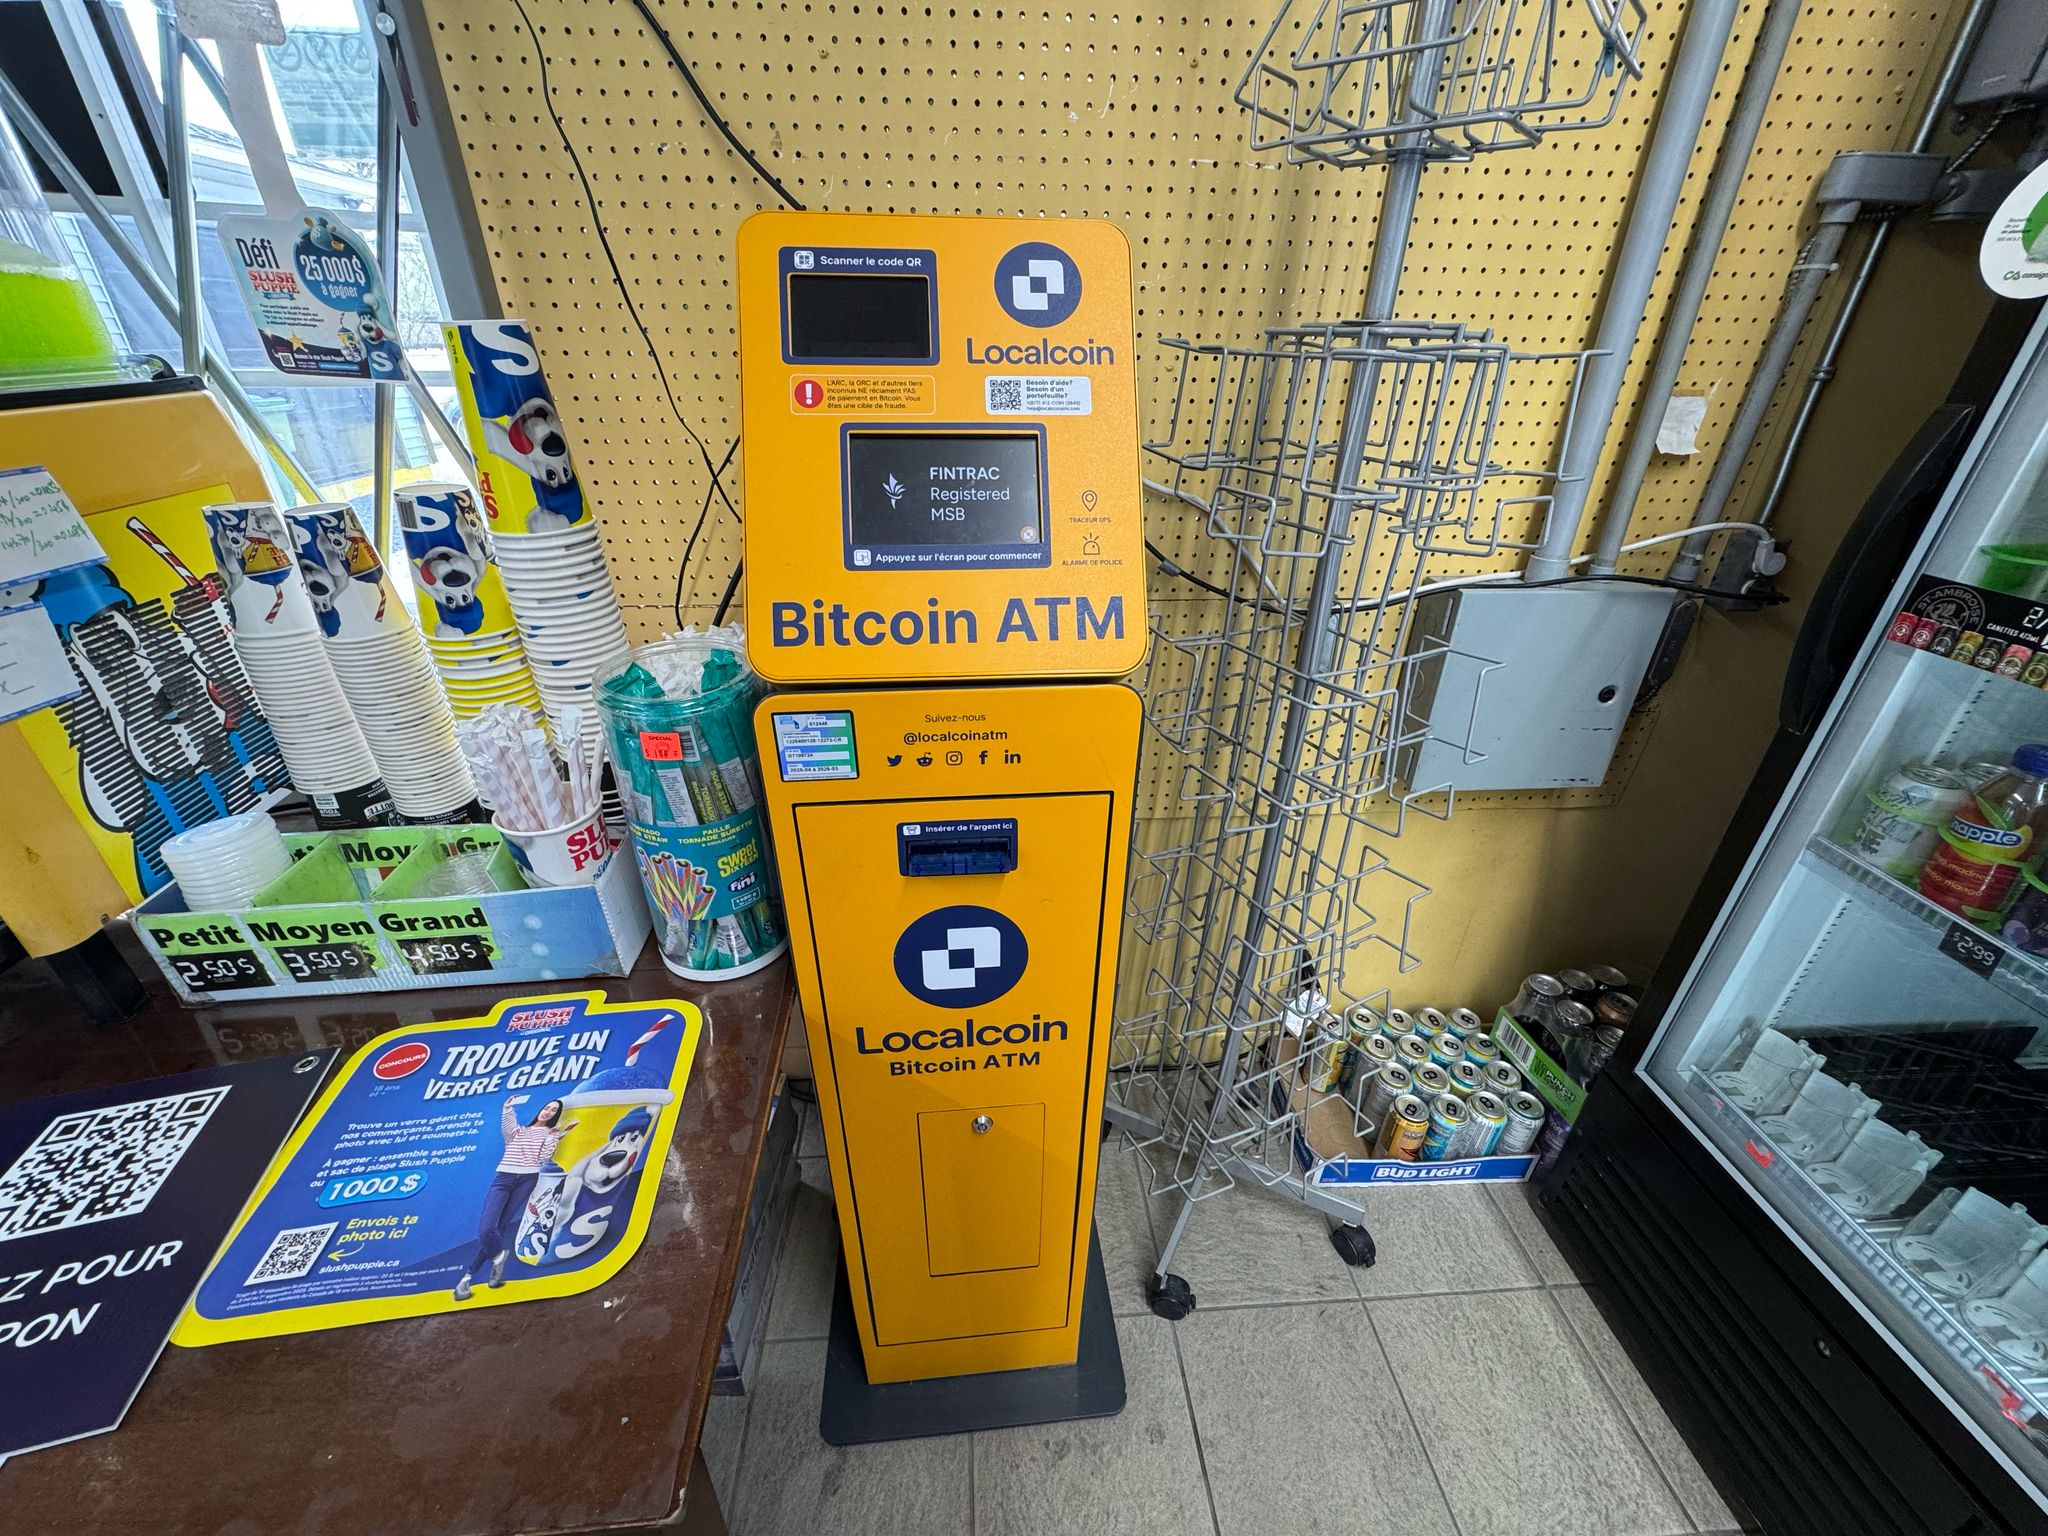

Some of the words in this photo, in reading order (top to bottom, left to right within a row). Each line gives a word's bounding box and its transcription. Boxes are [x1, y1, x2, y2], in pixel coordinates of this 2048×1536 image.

[235, 238, 280, 269] Défi
[820, 256, 864, 266] Scanner
[866, 256, 875, 266] le
[878, 256, 904, 266] code
[906, 259, 922, 267] QR
[248, 270, 296, 283] SLUSH
[253, 282, 300, 294] PUPPIE
[320, 282, 328, 296] à
[328, 285, 358, 299] gagner
[966, 337, 1115, 365] Localcoin
[930, 467, 1000, 480] FINTRAC
[930, 487, 1010, 504] Registered
[931, 508, 966, 521] MSB
[876, 552, 916, 564] Appuyez
[918, 554, 932, 562] sur
[934, 552, 965, 562] l'écran
[966, 554, 987, 564] pour
[989, 551, 1042, 561] commencer
[1918, 588, 1980, 625] ST-AMBROISE
[772, 597, 978, 647] Bitcoin
[996, 595, 1125, 643] ATM
[1987, 623, 2019, 637] CANETTES
[925, 714, 986, 723] Suivez-nous
[904, 730, 1008, 746] @localcoinatm
[678, 834, 719, 844] TORNADE
[720, 820, 754, 839] SURETTE
[703, 824, 731, 836] PAILLE
[925, 825, 955, 833] Insérer
[970, 824, 1001, 832] l'argent
[1003, 822, 1013, 830] ici
[644, 834, 668, 843] STRAW
[340, 842, 418, 863] Moy
[730, 872, 756, 892] Fini
[149, 925, 246, 948] Petit
[246, 919, 375, 944] Moyen
[379, 907, 489, 932] Grand
[402, 943, 460, 967] 4.50
[461, 942, 478, 959] $
[1957, 936, 1996, 966] 2.99
[176, 959, 238, 986] 2.50
[238, 957, 256, 975] $
[282, 951, 342, 977] 3.50
[342, 950, 360, 966] $
[506, 1016, 572, 1034] PUPPIE
[511, 1006, 576, 1024] SLUSH
[856, 1014, 1068, 1054] Localcoin
[378, 1052, 427, 1070] CONCOURS
[439, 1034, 564, 1077] TROUVE
[568, 1029, 610, 1052] UN
[890, 1056, 976, 1077] Bitcoin
[983, 1052, 1040, 1070] ATM
[424, 1073, 506, 1100] VERRE
[504, 1055, 600, 1090] GÉANT
[1546, 1070, 1576, 1101] PUNCH
[340, 1132, 360, 1140] nos
[362, 1126, 434, 1138] commerçants,
[434, 1120, 472, 1132] prends
[348, 1122, 384, 1132] Trouve
[400, 1118, 428, 1126] verre
[428, 1114, 458, 1126] géant
[334, 1138, 366, 1150] photo
[367, 1138, 393, 1146] avec
[394, 1135, 408, 1144] lui
[420, 1129, 480, 1140] soumets-la.
[316, 1170, 328, 1178] et
[330, 1168, 349, 1176] sac
[351, 1166, 364, 1174] de
[366, 1162, 397, 1174] plage
[400, 1158, 428, 1168] Slush
[430, 1154, 466, 1166] Puppie
[322, 1158, 332, 1168] À
[334, 1156, 372, 1168] gagner
[378, 1149, 429, 1162] ensemble
[430, 1144, 477, 1155] serviette
[1376, 1168, 1418, 1178] BUD
[1418, 1166, 1476, 1178] LIGHT
[310, 1180, 326, 1188] ou
[400, 1173, 422, 1193] $
[346, 1218, 399, 1230] Envois
[402, 1214, 419, 1226] ta
[336, 1230, 386, 1245] photo
[388, 1228, 410, 1239] ici
[40, 1240, 184, 1294] POUR
[318, 1260, 400, 1274] slushpuppie.ca
